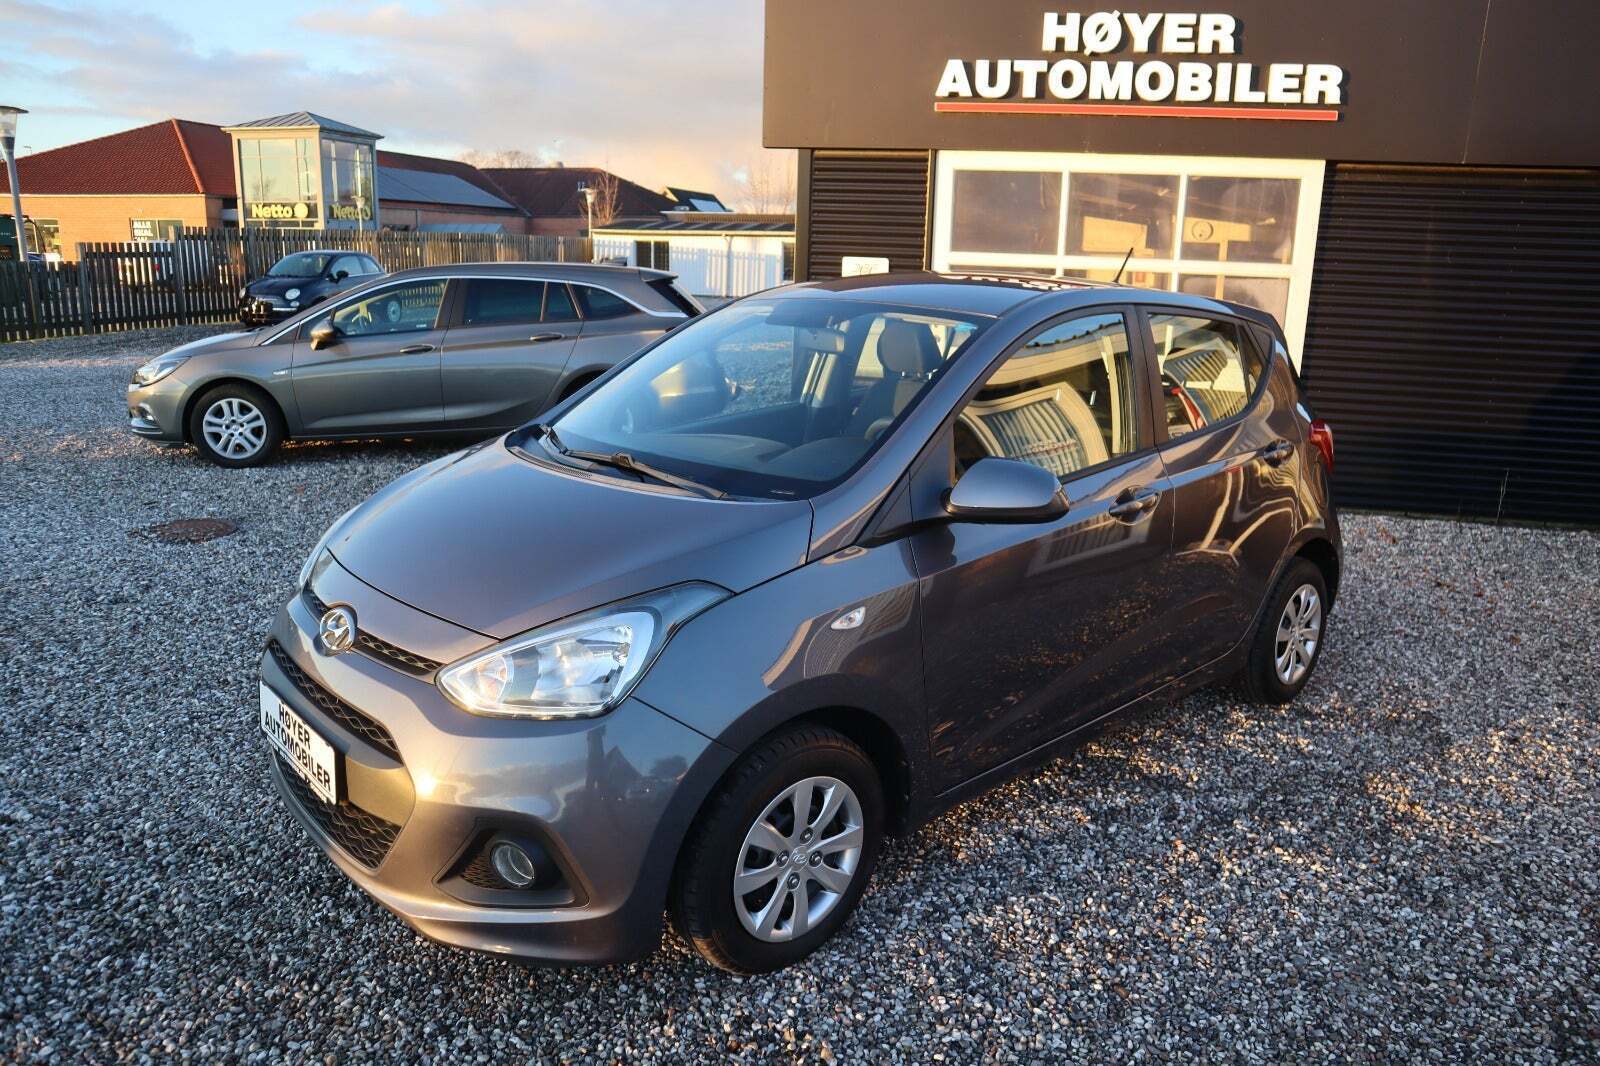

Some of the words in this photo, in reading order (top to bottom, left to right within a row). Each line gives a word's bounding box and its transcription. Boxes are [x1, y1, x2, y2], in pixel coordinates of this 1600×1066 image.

[1042, 10, 1236, 56] HØYER
[935, 59, 1343, 104] AUTOMOBILER
[251, 203, 292, 218] Netto
[332, 204, 361, 219] Netto
[279, 703, 311, 750] HØYER
[265, 711, 331, 791] AUTOMOBILER
